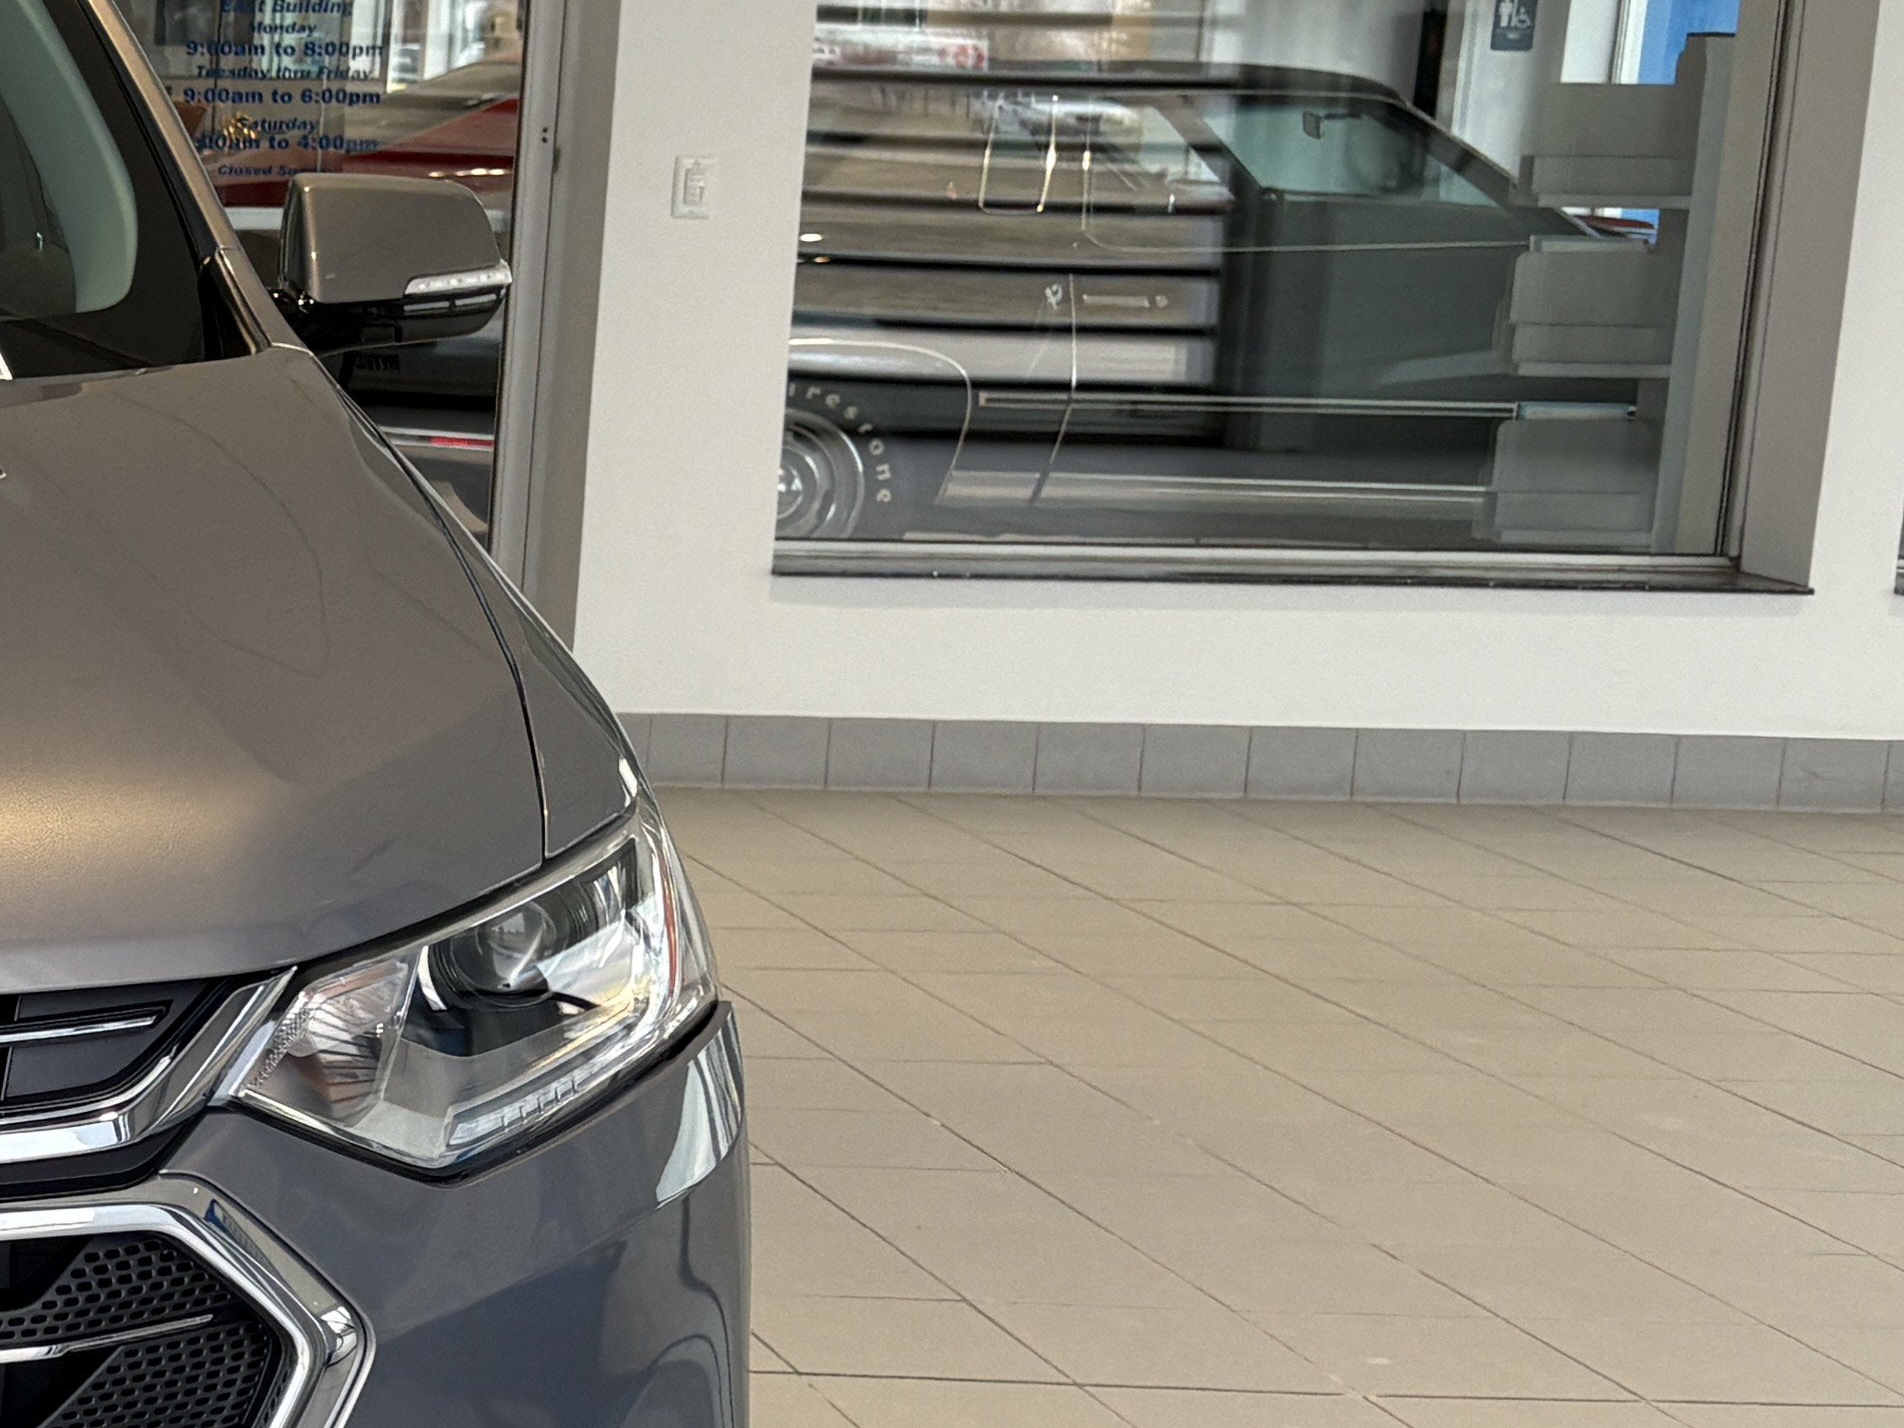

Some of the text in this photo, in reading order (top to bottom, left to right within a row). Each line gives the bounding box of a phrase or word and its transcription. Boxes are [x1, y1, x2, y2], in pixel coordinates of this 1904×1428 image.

[275, 42, 295, 57] to
[303, 41, 384, 63] 8:00pm
[183, 89, 381, 107] 9:00am to 6:00pm
[268, 136, 289, 151] to
[298, 135, 379, 155] 4:00pm
[218, 164, 273, 177] Closed
